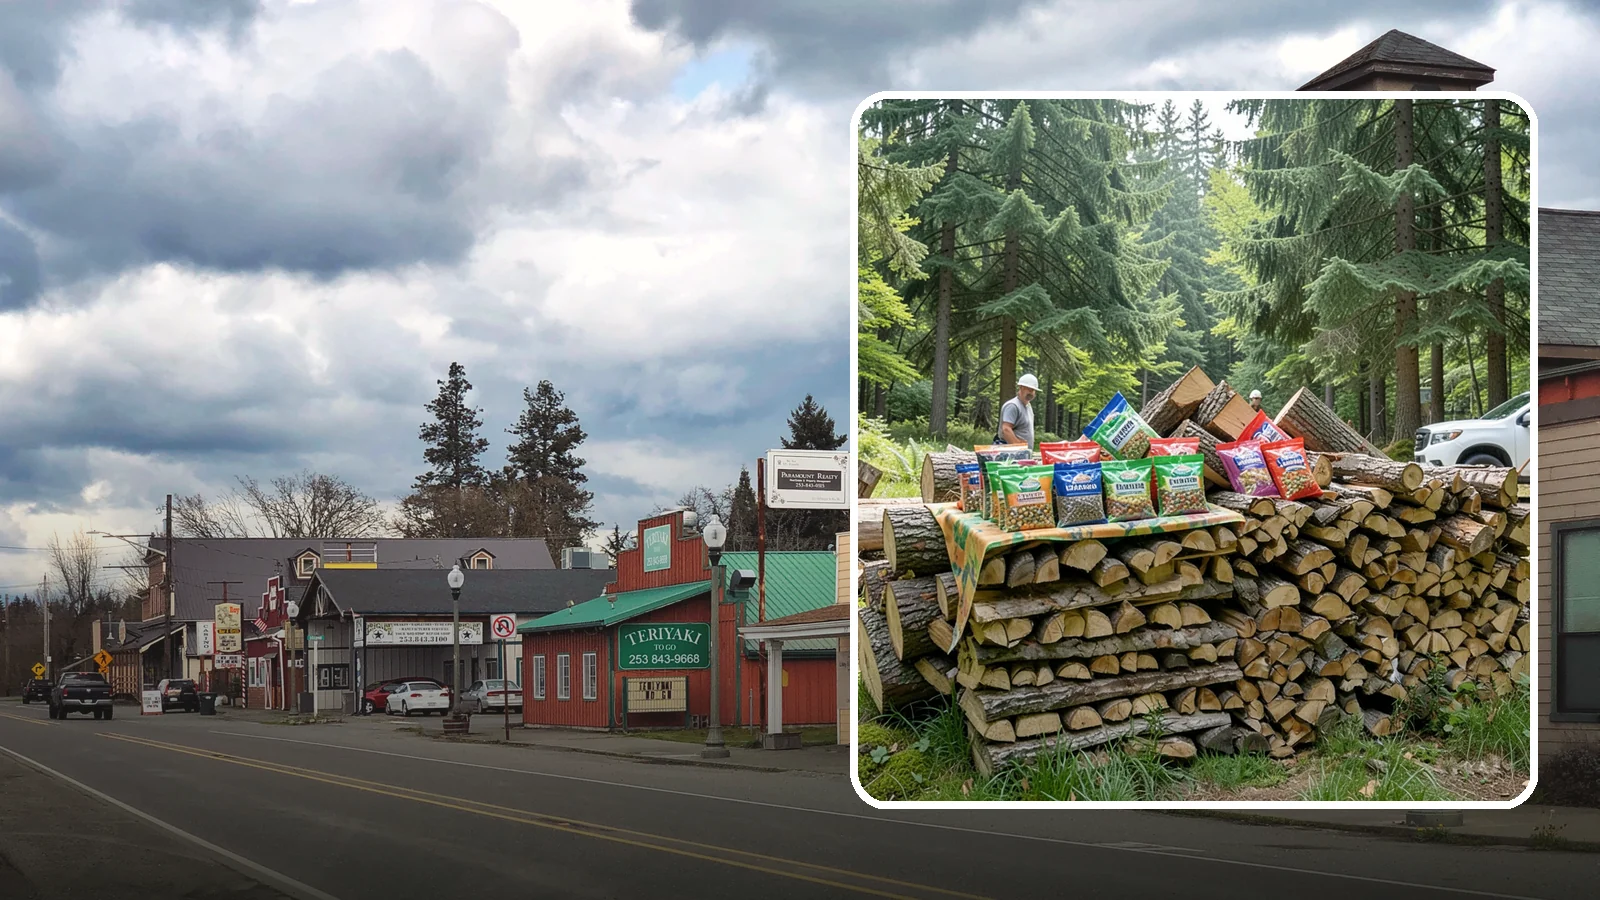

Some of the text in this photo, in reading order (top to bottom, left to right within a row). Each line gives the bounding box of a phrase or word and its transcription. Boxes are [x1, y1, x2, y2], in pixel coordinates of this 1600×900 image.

[781, 471, 839, 480] PARAMOUNT REALTY
[625, 628, 702, 646] TERIYAKI
[629, 654, 700, 664] 253 843-9668
